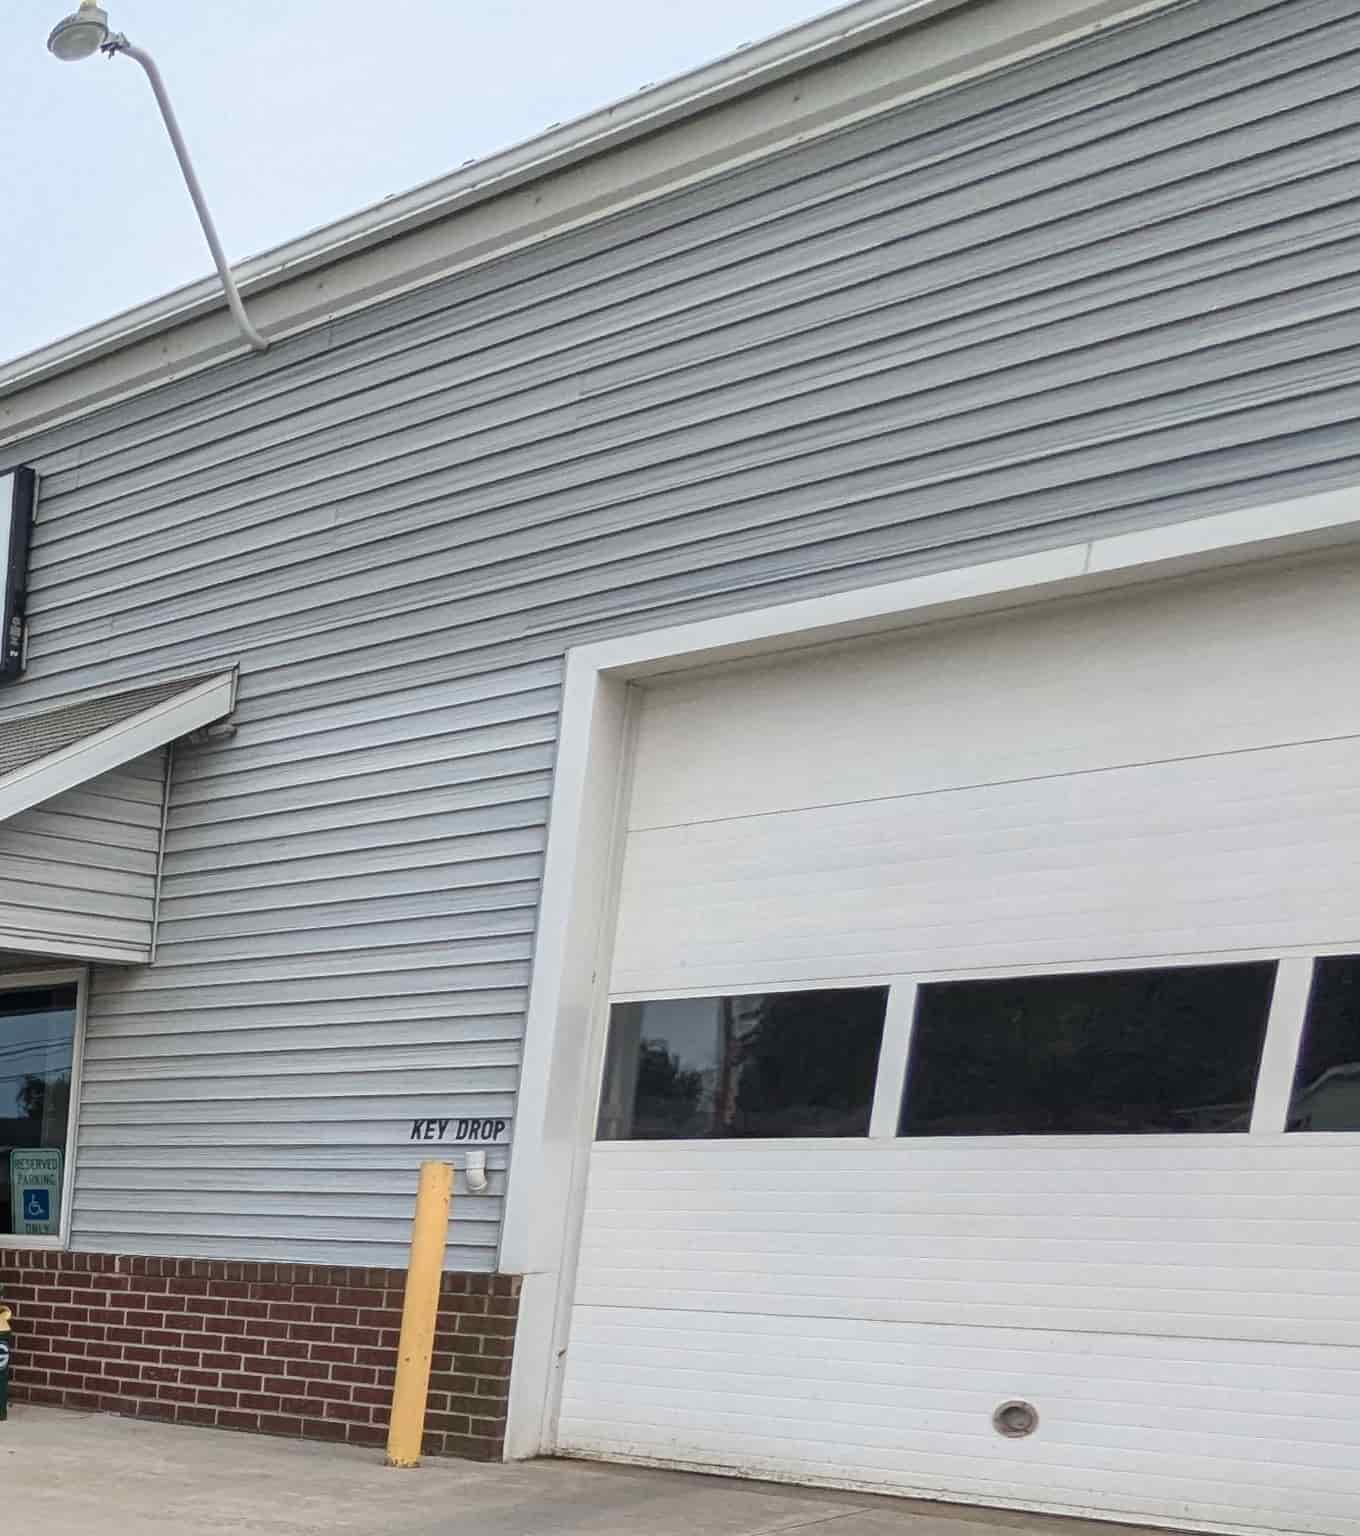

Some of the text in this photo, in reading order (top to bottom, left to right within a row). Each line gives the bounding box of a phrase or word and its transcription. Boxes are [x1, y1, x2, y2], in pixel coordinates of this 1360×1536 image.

[410, 1119, 506, 1141] KEY DROP
[15, 1158, 58, 1170] RESERVED
[15, 1173, 56, 1186] PARKING
